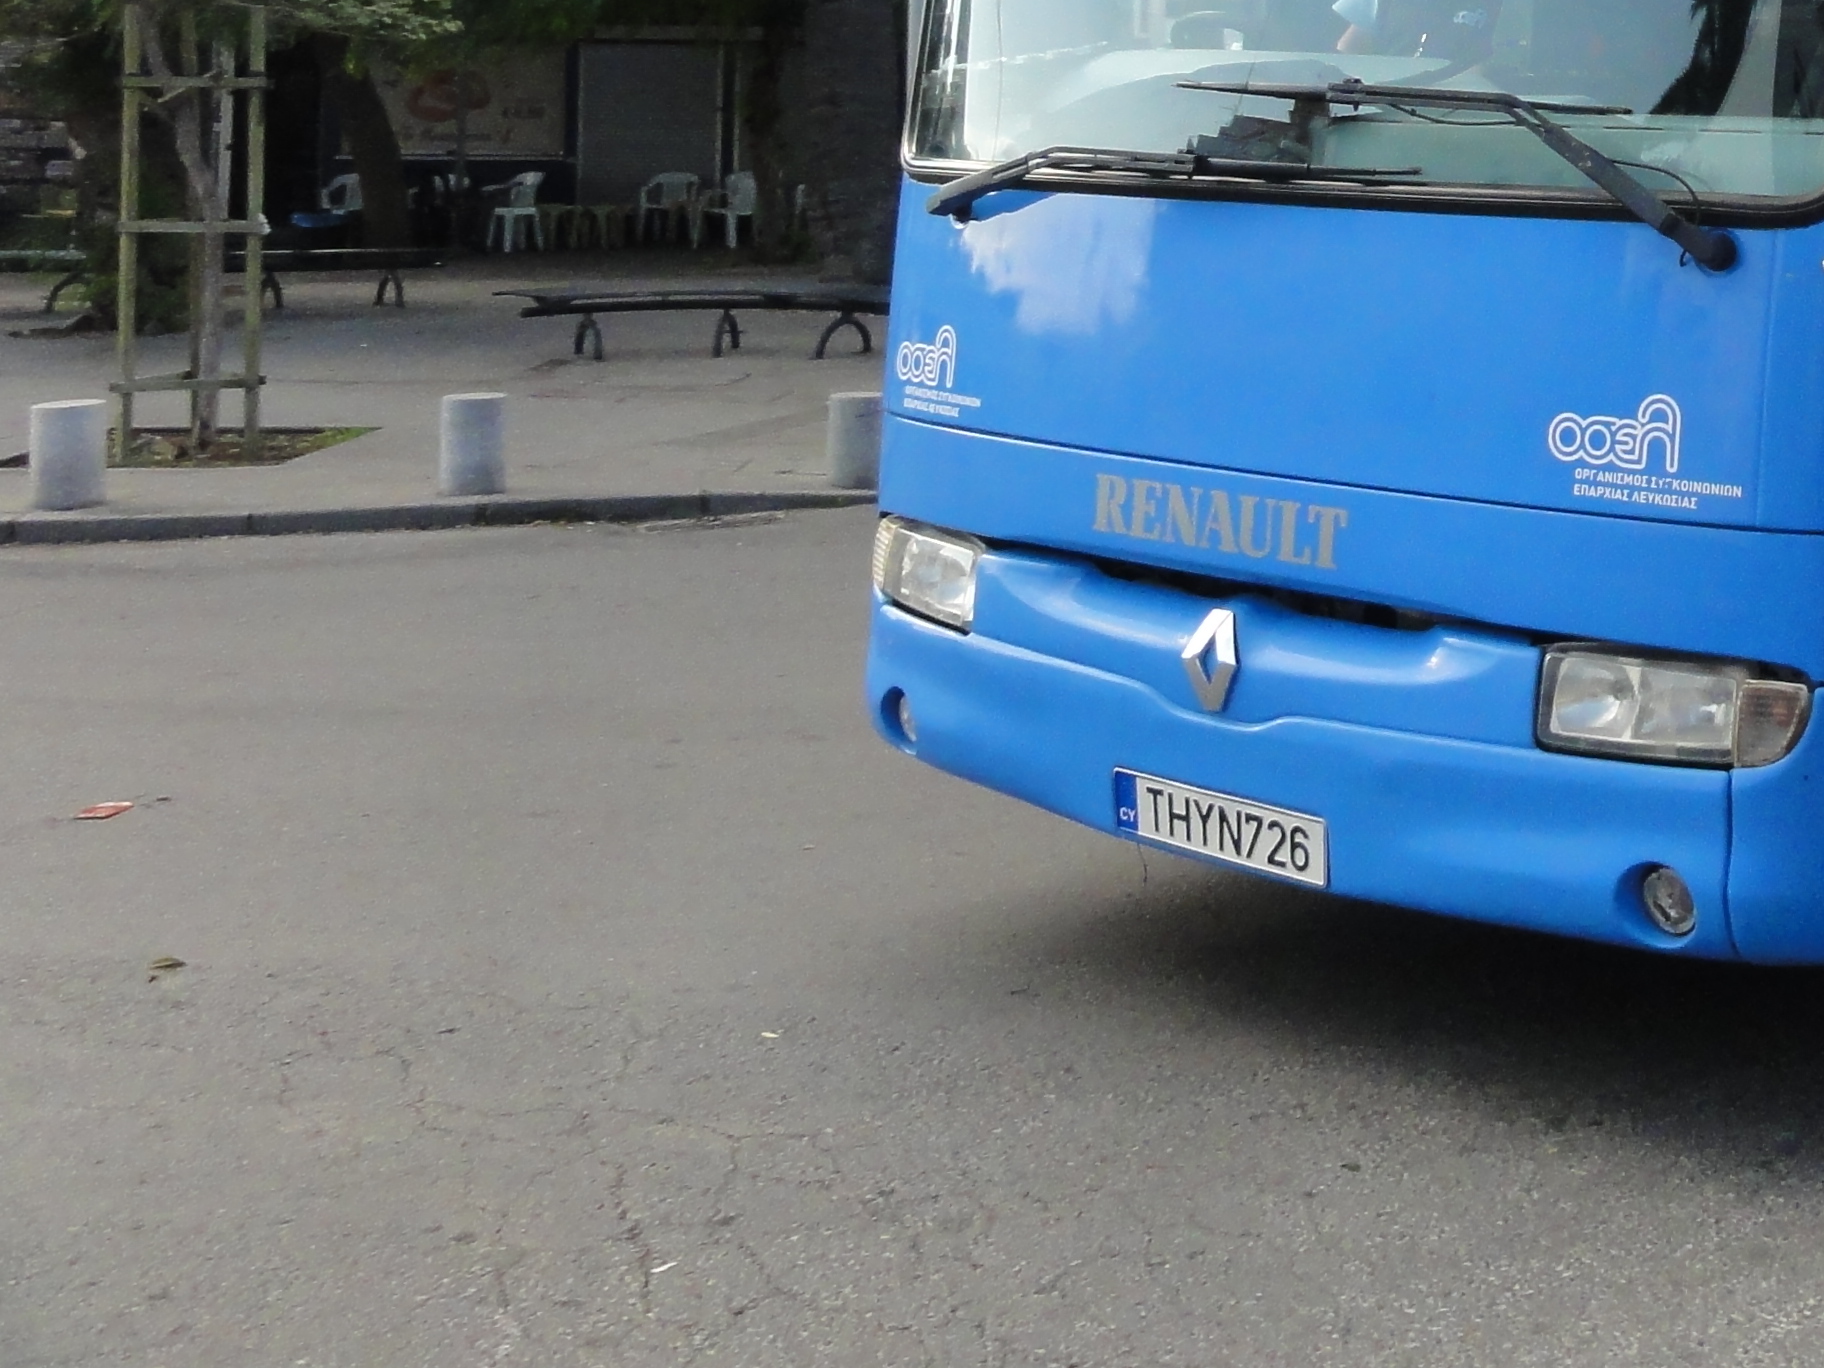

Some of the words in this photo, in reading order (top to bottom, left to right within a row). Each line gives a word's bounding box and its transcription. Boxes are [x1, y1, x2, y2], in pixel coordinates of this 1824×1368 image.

[1574, 467, 1648, 488] ΟΡΓΑΝΙΣΜΟΣ
[1573, 483, 1630, 502] ΕΠΑΡΧΙΑΣ
[1631, 490, 1698, 510] ΛΕΥΚΩΣΙΑΣ
[1093, 473, 1348, 570] RENAULT
[1119, 805, 1137, 824] CY
[1145, 786, 1311, 873] THYN726
